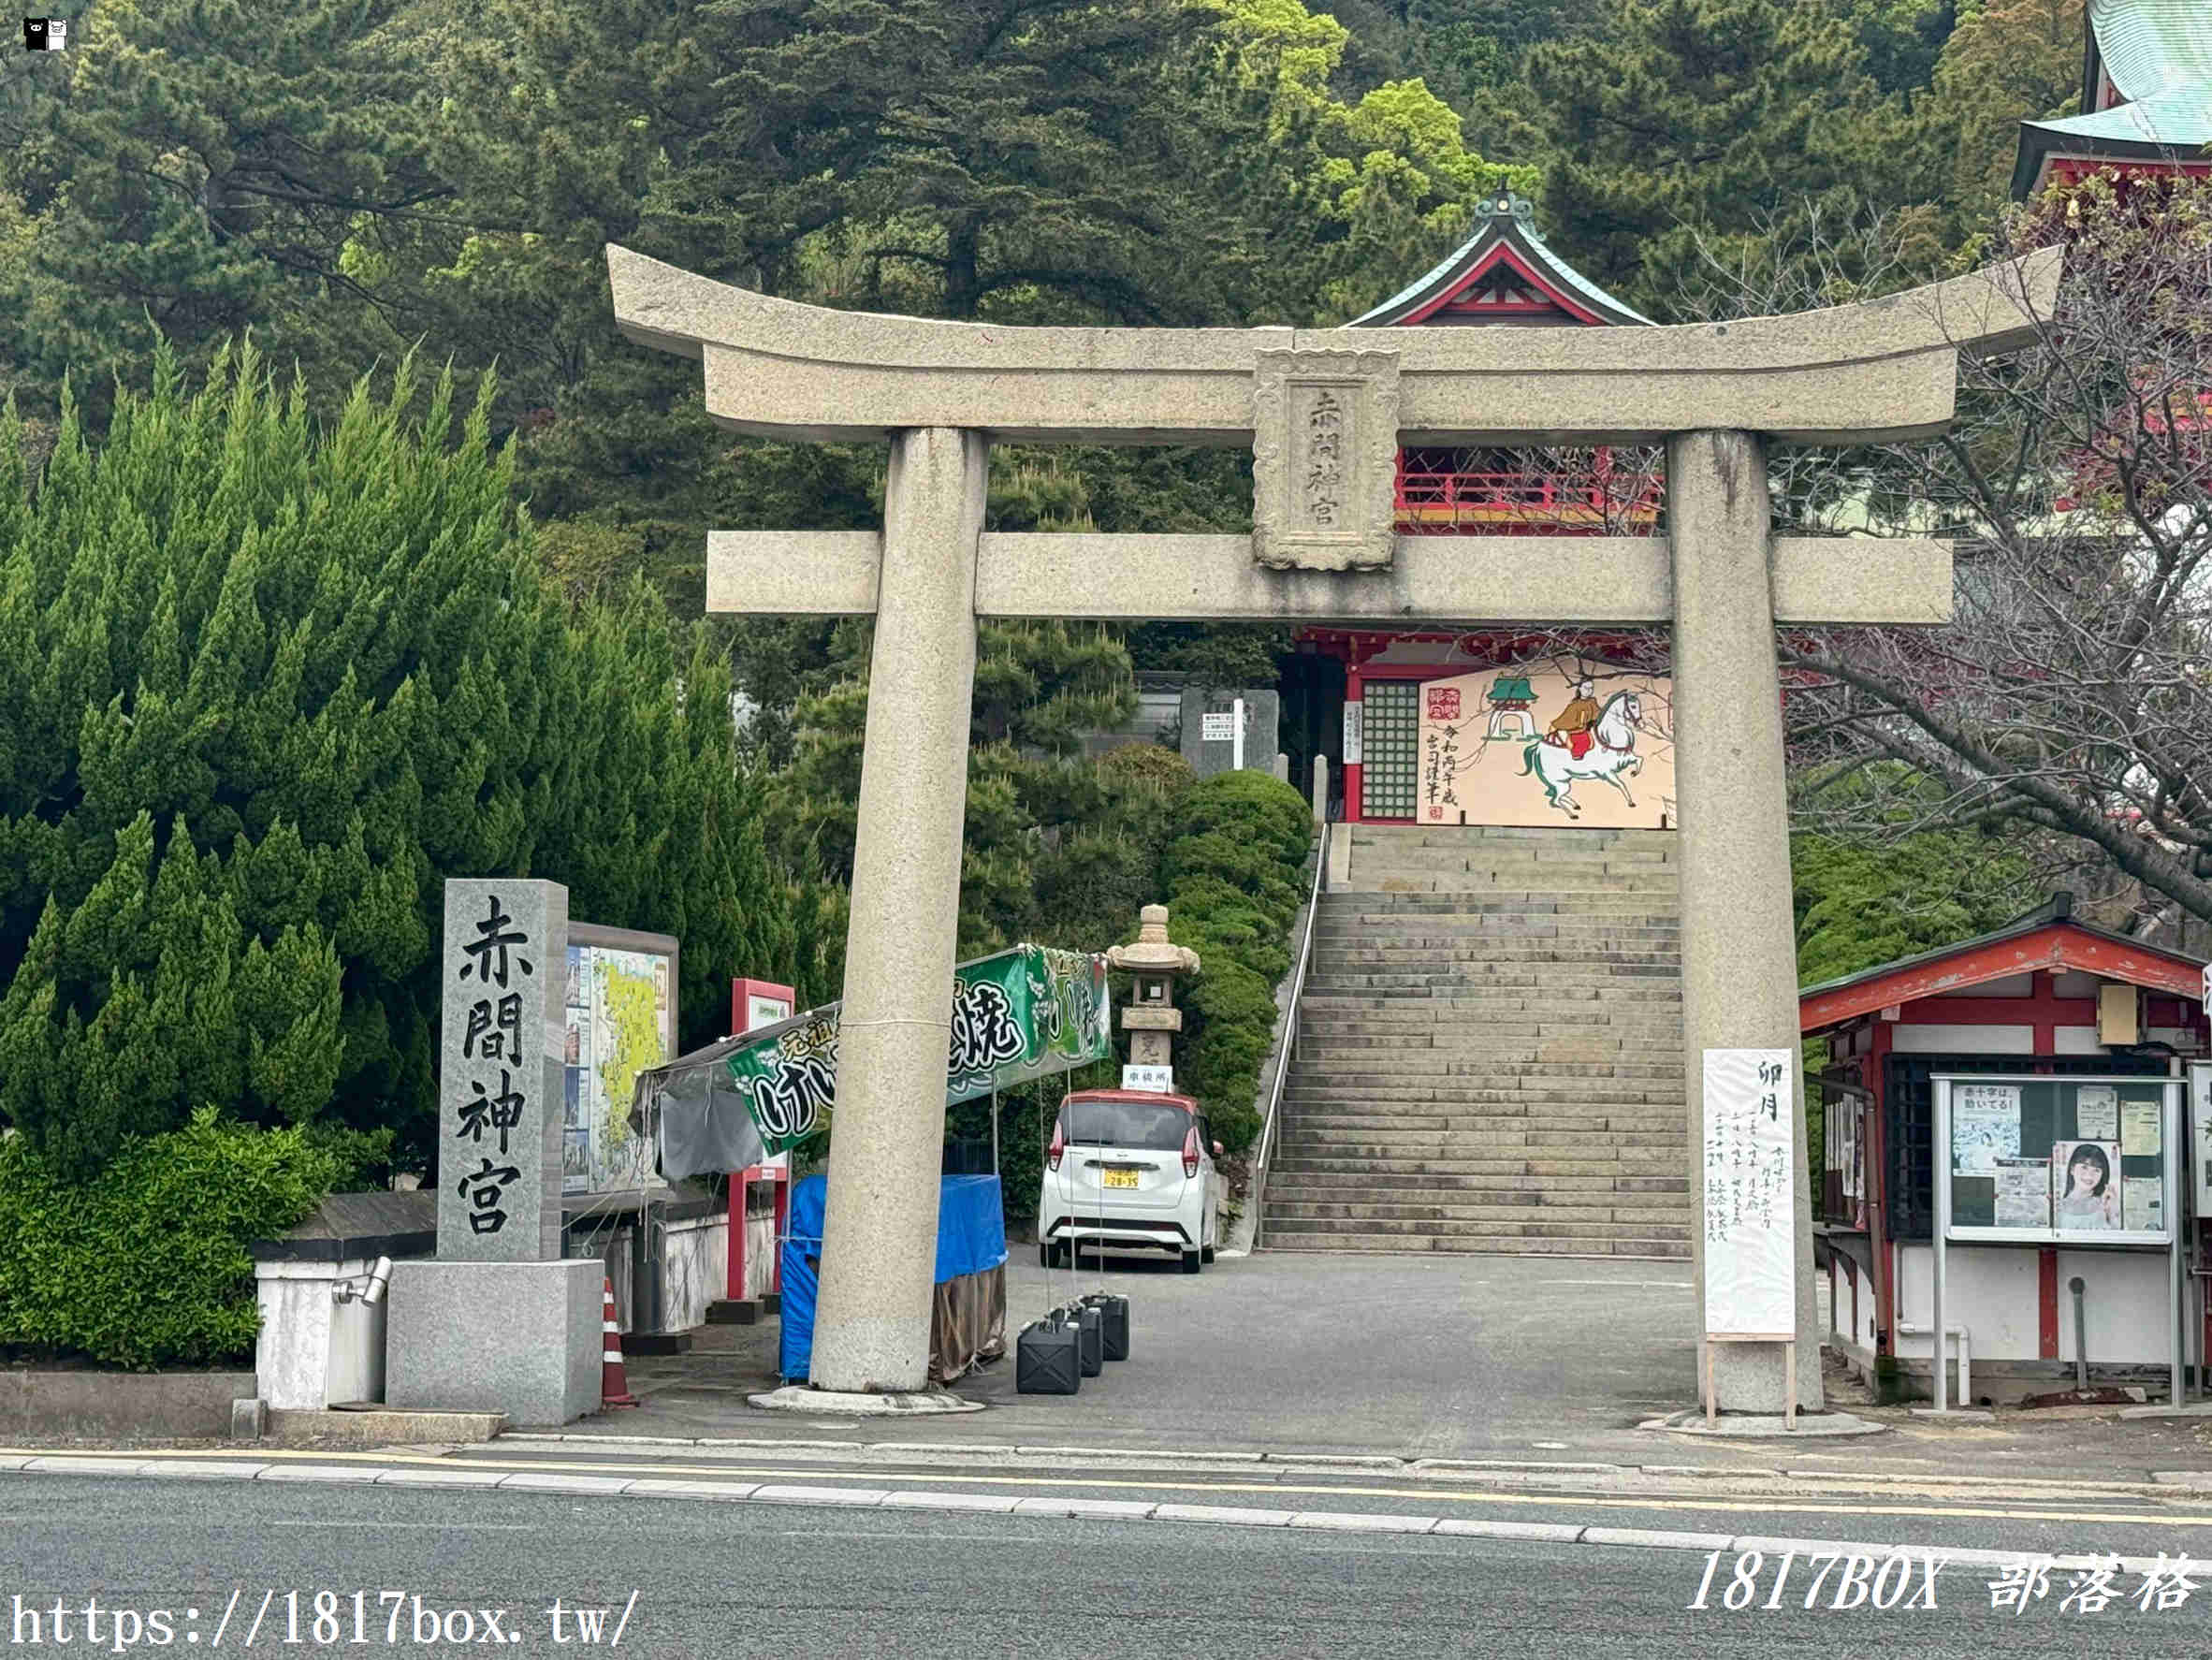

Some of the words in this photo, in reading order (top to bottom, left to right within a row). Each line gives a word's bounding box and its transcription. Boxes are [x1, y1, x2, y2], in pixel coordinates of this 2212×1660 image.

[1308, 391, 1341, 526] 赤間神宮
[456, 895, 533, 1236] 赤間神宮
[1758, 1060, 1783, 1122] 卯月
